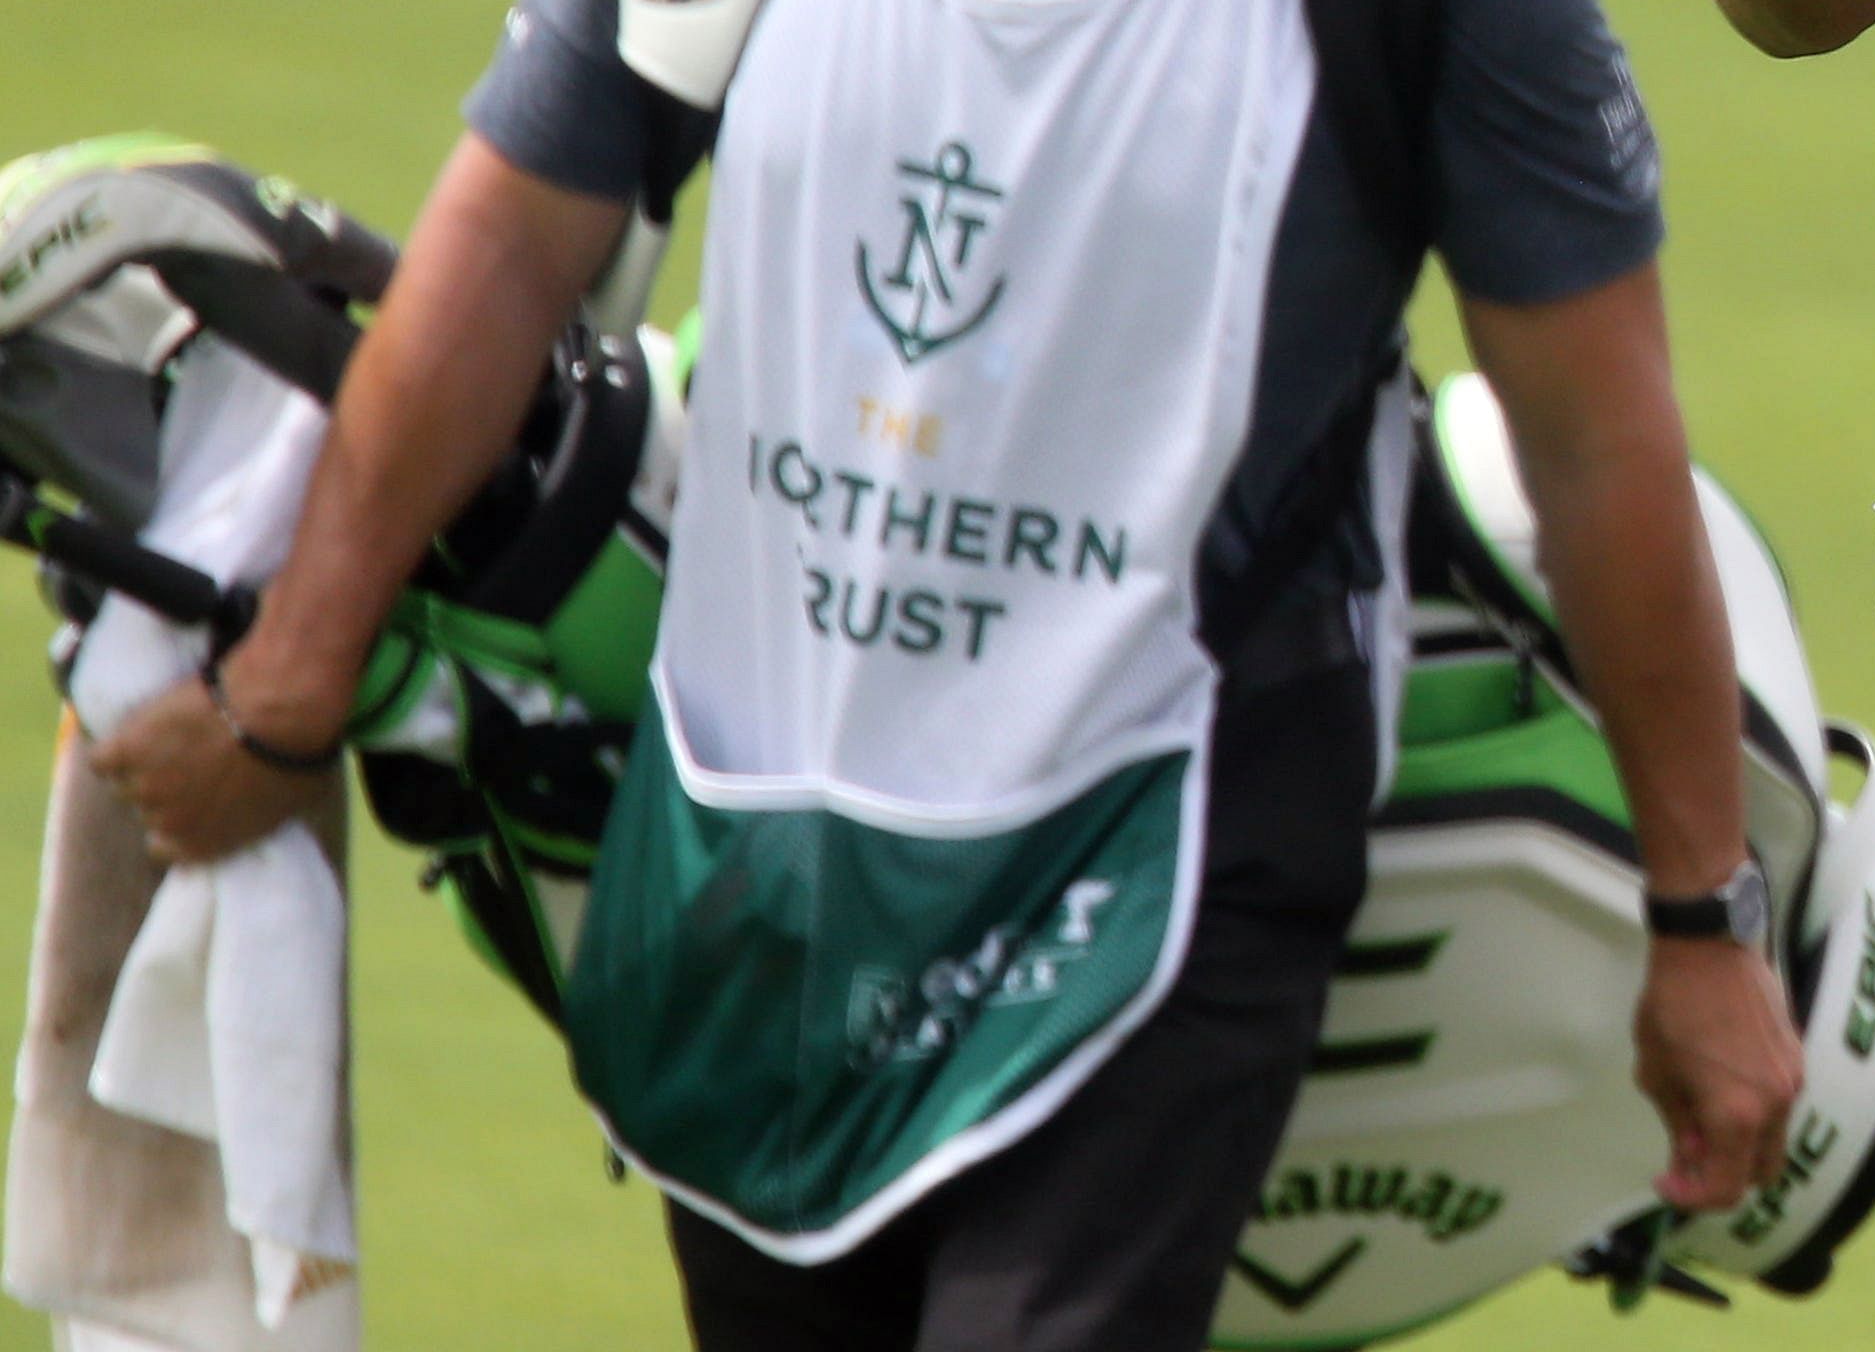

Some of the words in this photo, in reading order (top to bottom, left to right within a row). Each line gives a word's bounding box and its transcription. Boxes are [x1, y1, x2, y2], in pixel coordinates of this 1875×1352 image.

[857, 395, 945, 459] THE
[748, 432, 1127, 586] OTHERN
[799, 548, 1006, 662] RUST
[1729, 1109, 1840, 1246] EPIC
